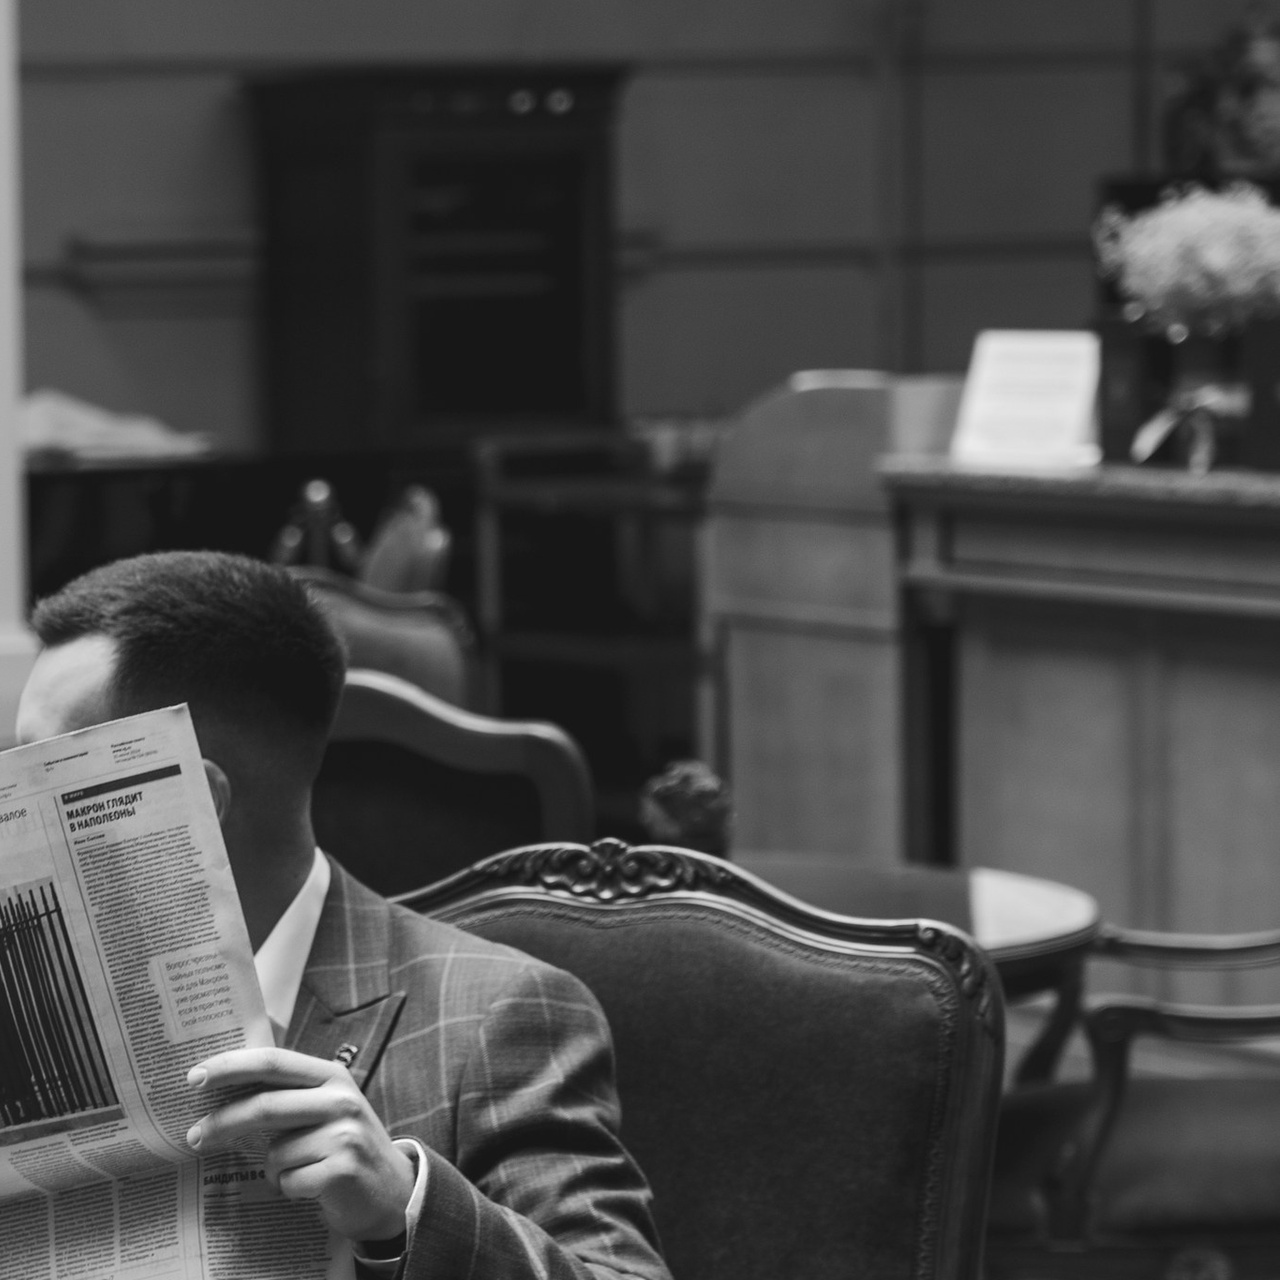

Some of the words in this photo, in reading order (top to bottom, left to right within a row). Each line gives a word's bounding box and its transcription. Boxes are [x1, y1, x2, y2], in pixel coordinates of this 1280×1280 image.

[66, 802, 105, 821] МАКРОН
[106, 791, 143, 811] ГЛЯДИТ
[70, 823, 76, 832] В
[78, 807, 136, 831] НАПОЛЕОНЫ
[203, 1172, 249, 1186] БАНДИТЫ
